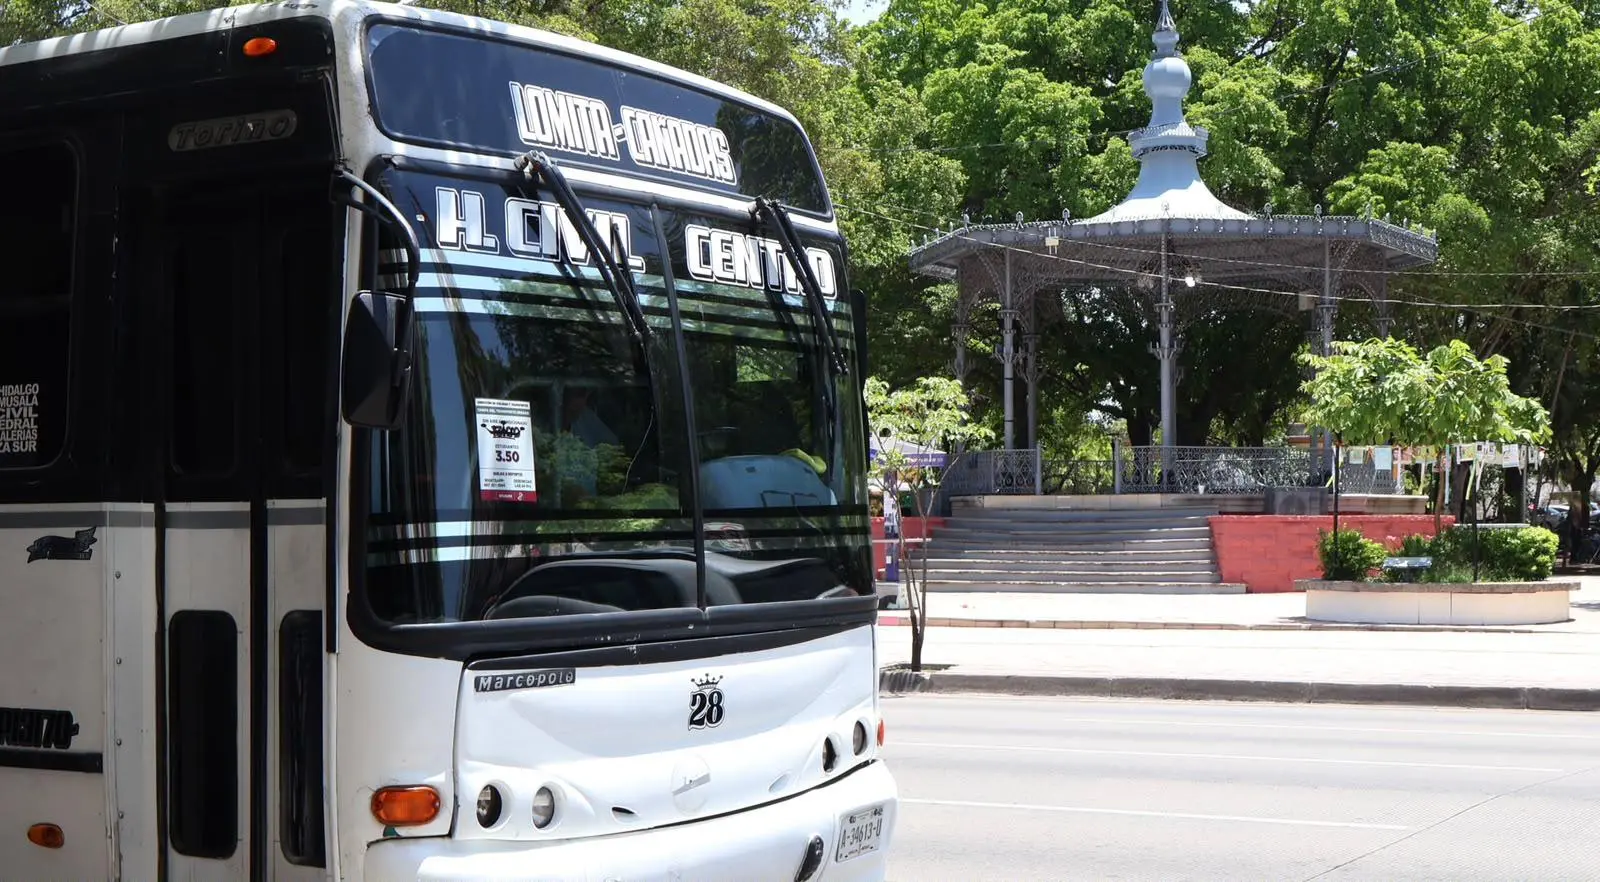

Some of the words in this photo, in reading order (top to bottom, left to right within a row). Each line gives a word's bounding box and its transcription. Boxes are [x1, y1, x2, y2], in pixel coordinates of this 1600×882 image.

[176, 115, 290, 149] Torino
[435, 186, 500, 254] H.
[504, 196, 646, 273] CIVIL
[12, 440, 37, 453] SUR
[495, 450, 520, 463] 3.50
[478, 671, 574, 691] Marcopolo
[688, 687, 726, 731] 28
